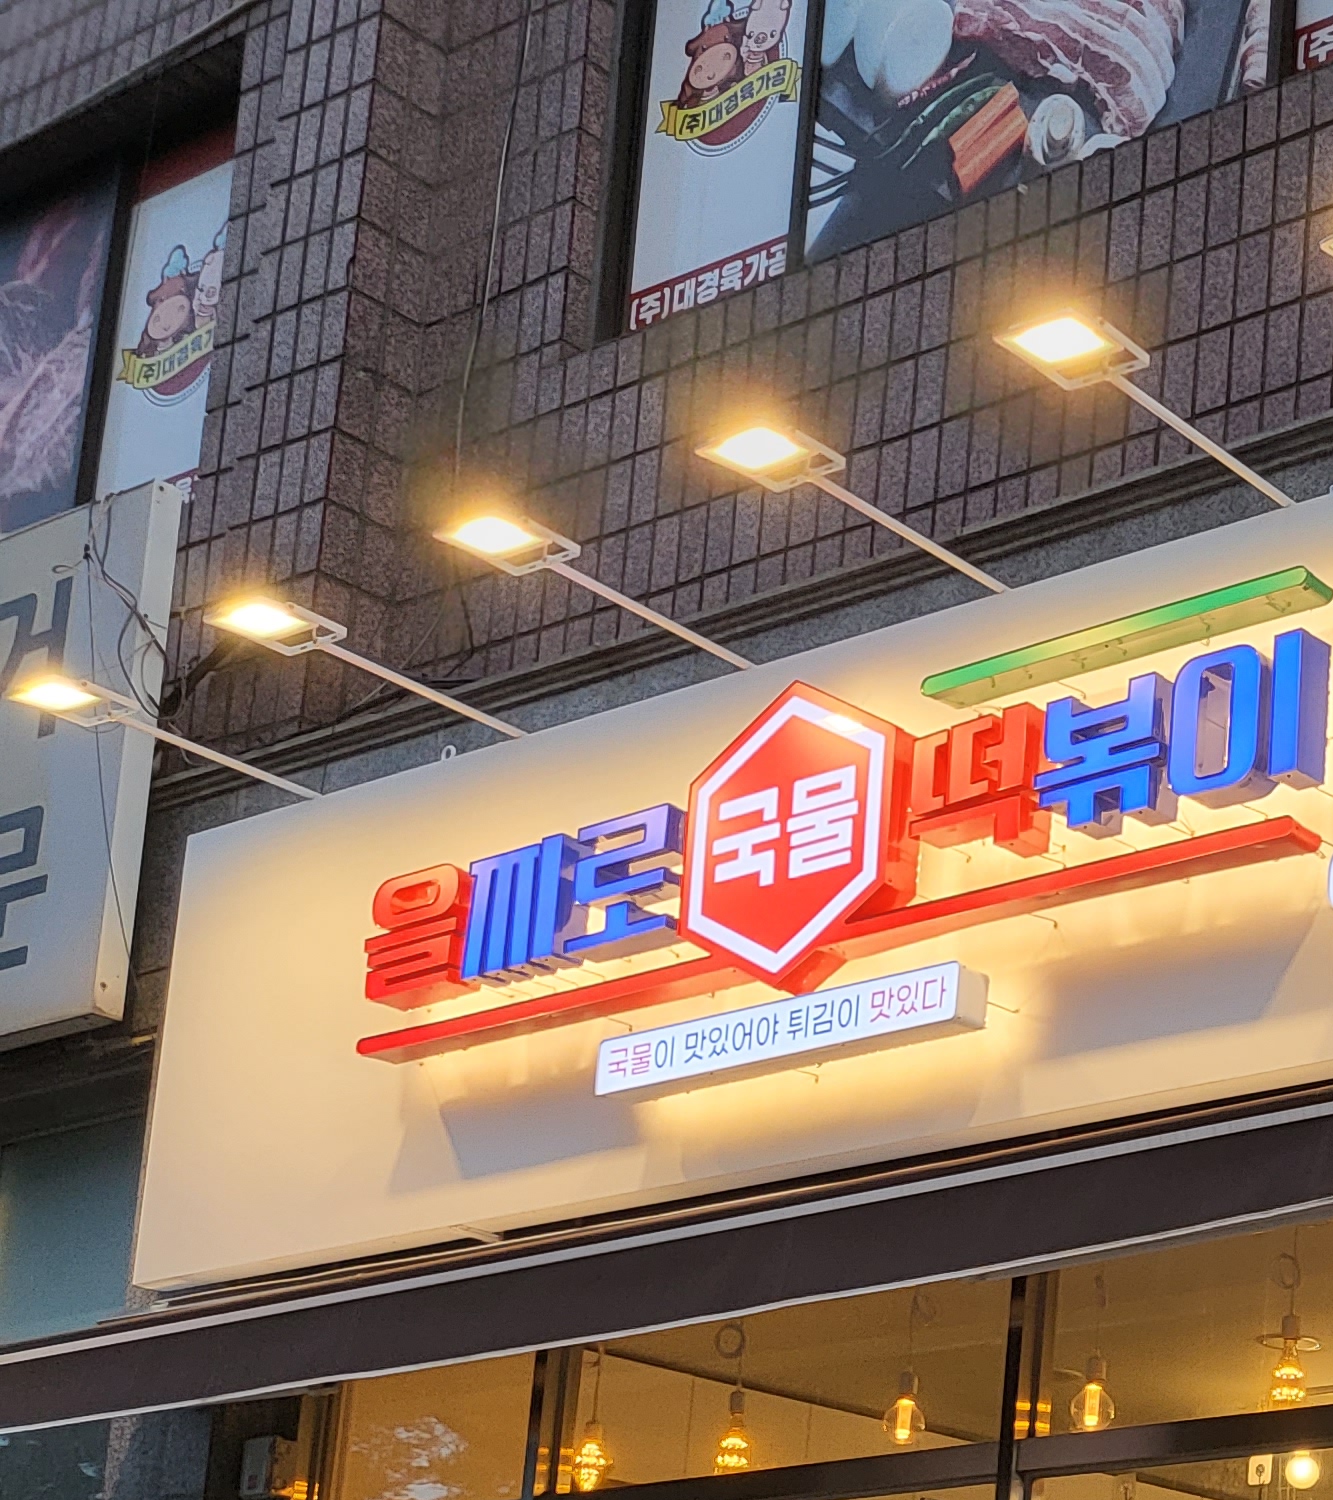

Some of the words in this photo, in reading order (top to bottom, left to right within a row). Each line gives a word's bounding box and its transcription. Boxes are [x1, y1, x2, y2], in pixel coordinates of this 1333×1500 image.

[678, 63, 788, 136] (주)대경육가공
[711, 764, 860, 888] 국물
[910, 627, 1332, 857] 떡볶이
[607, 1036, 675, 1077] 국물이
[684, 1013, 779, 1063] 맛있어야
[786, 994, 860, 1041] 튀김이
[869, 975, 947, 1023] 맛있다
